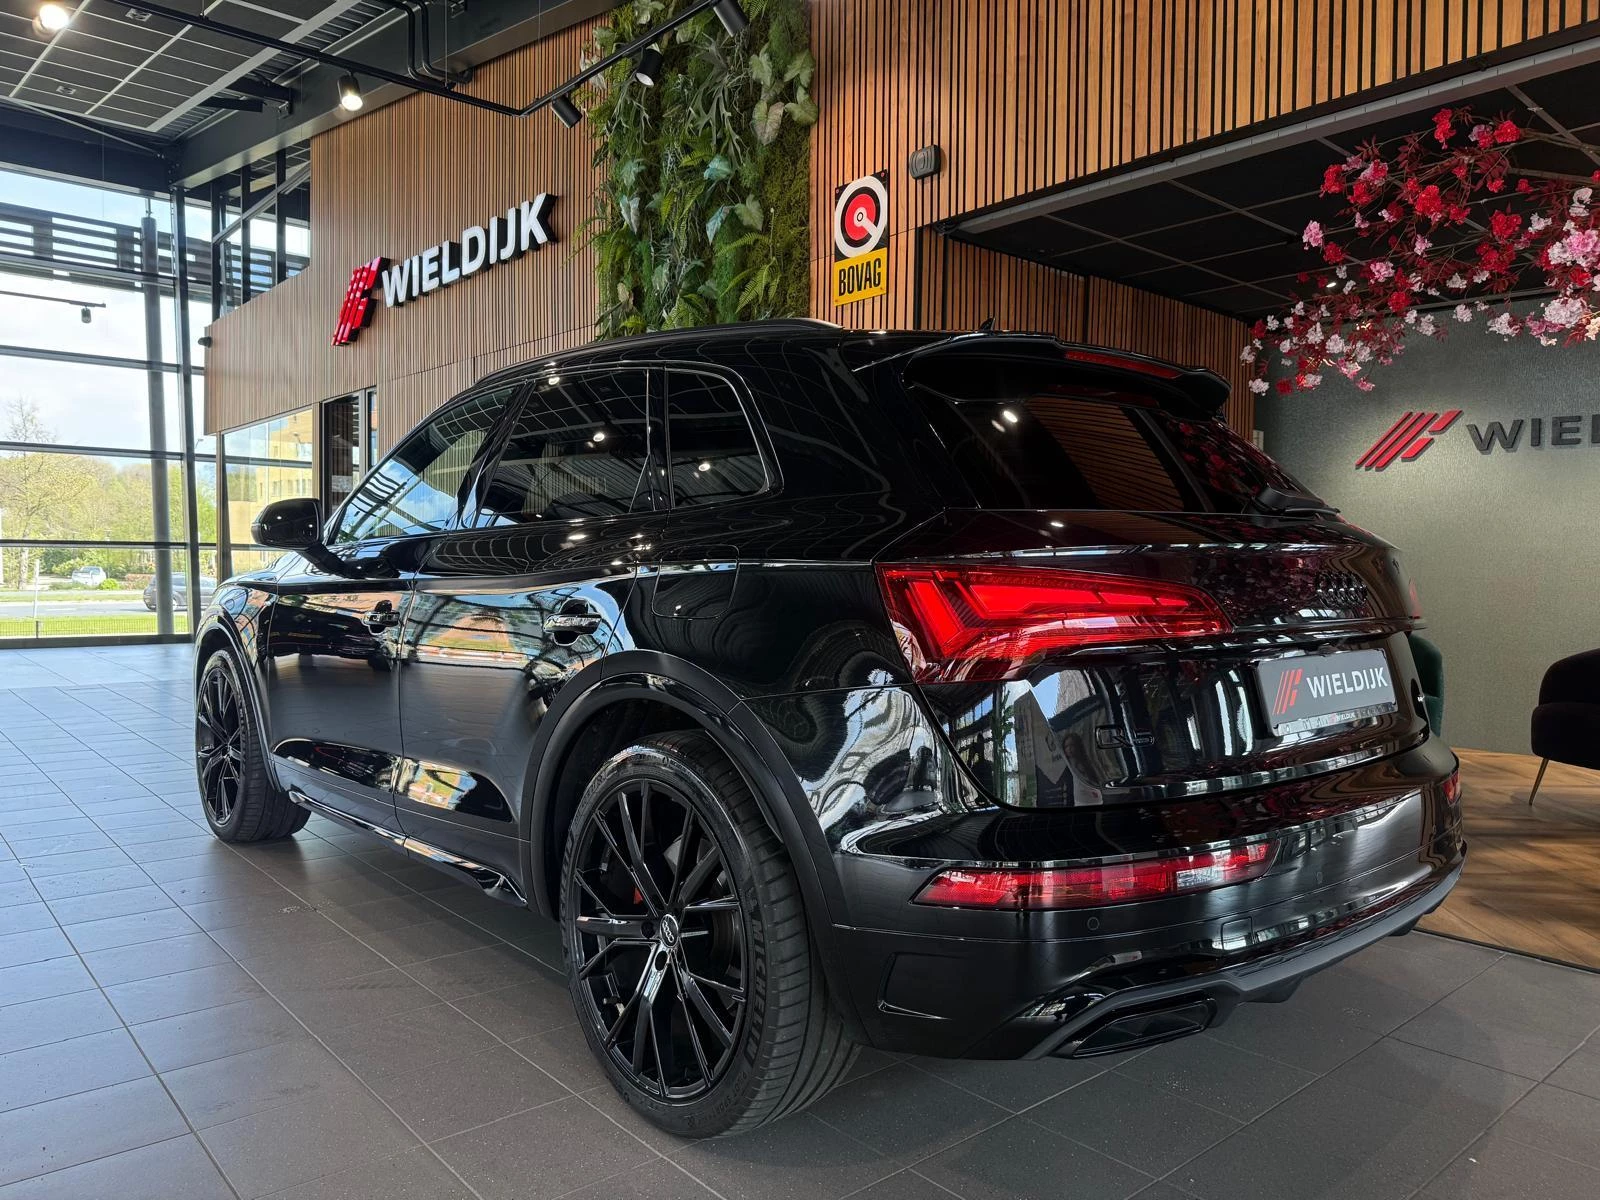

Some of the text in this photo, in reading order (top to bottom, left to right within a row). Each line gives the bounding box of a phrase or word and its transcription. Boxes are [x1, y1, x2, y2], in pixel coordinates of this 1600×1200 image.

[381, 192, 548, 308] WIELDIJK
[838, 257, 881, 297] BOVAG
[1306, 667, 1388, 699] WIELDIJK
[748, 917, 767, 1061] MICHELIN
